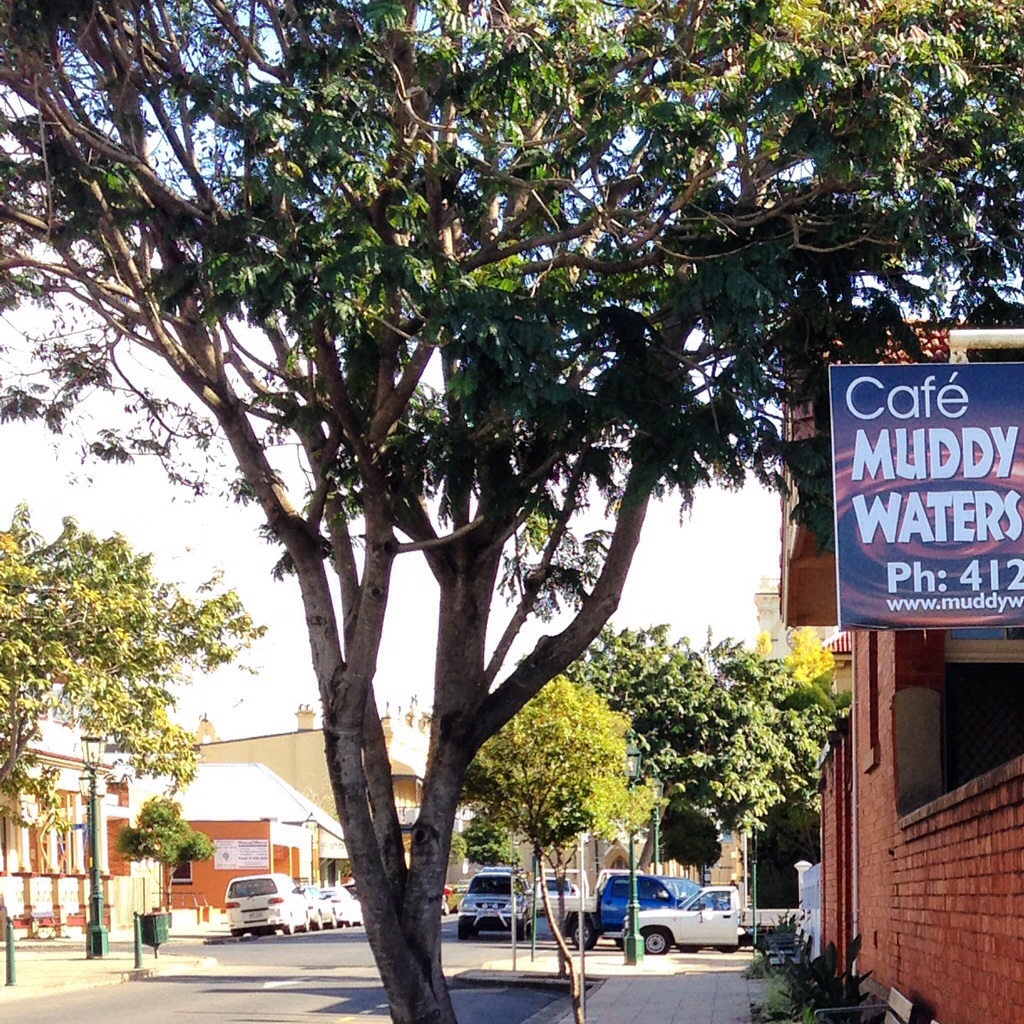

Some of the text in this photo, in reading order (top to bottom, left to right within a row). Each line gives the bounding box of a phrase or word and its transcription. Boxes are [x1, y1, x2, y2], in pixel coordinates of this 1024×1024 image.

[845, 371, 969, 420] Café
[851, 426, 1019, 481] MUDDY
[852, 489, 1024, 545] WATERS
[886, 561, 947, 594] Ph:
